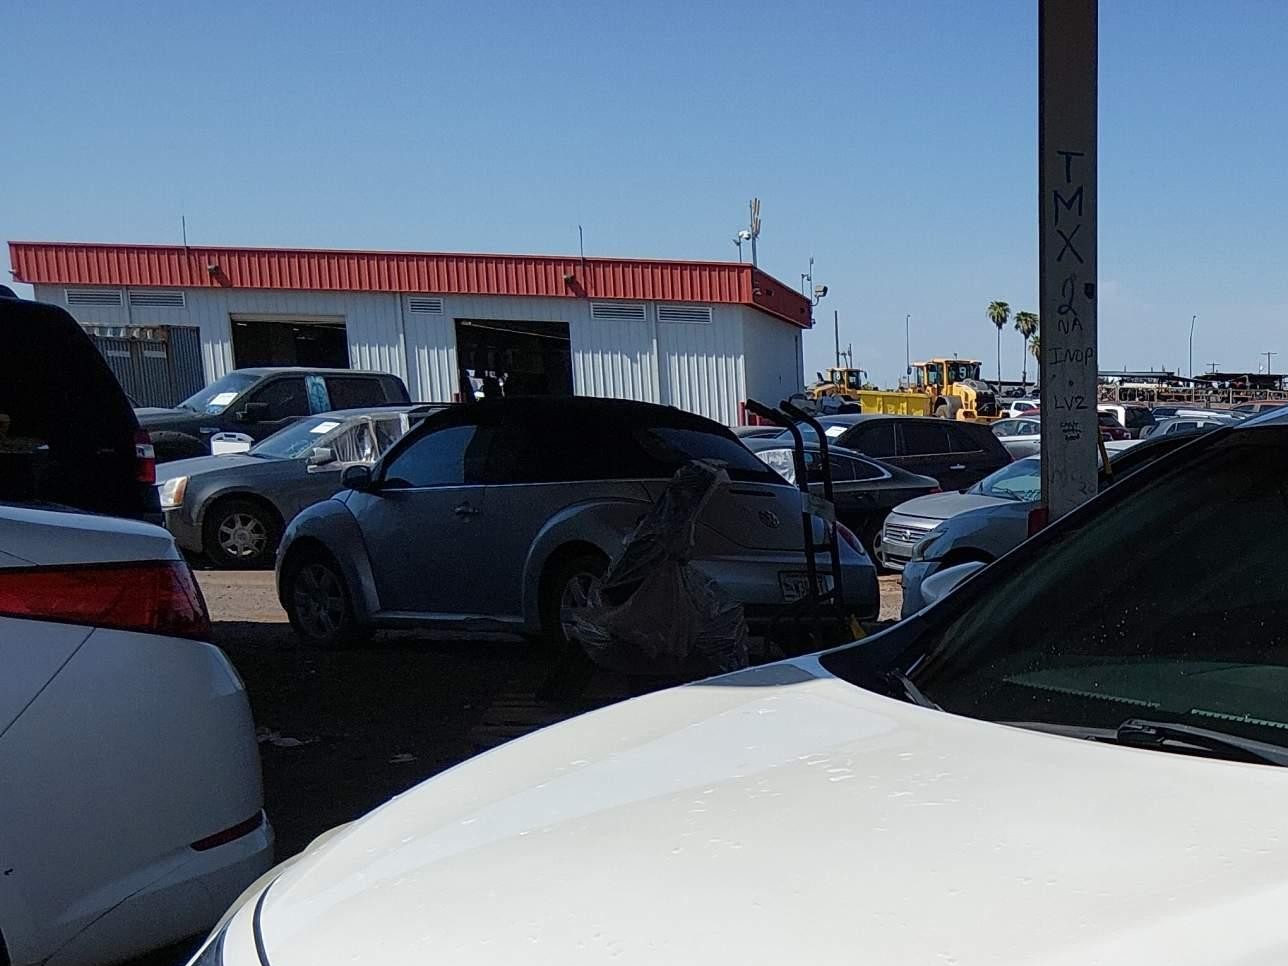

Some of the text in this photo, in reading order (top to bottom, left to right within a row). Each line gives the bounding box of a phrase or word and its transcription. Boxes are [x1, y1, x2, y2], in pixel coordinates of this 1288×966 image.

[1054, 150, 1085, 265] TMX
[1057, 317, 1083, 334] NA
[1054, 396, 1088, 411] LV2
